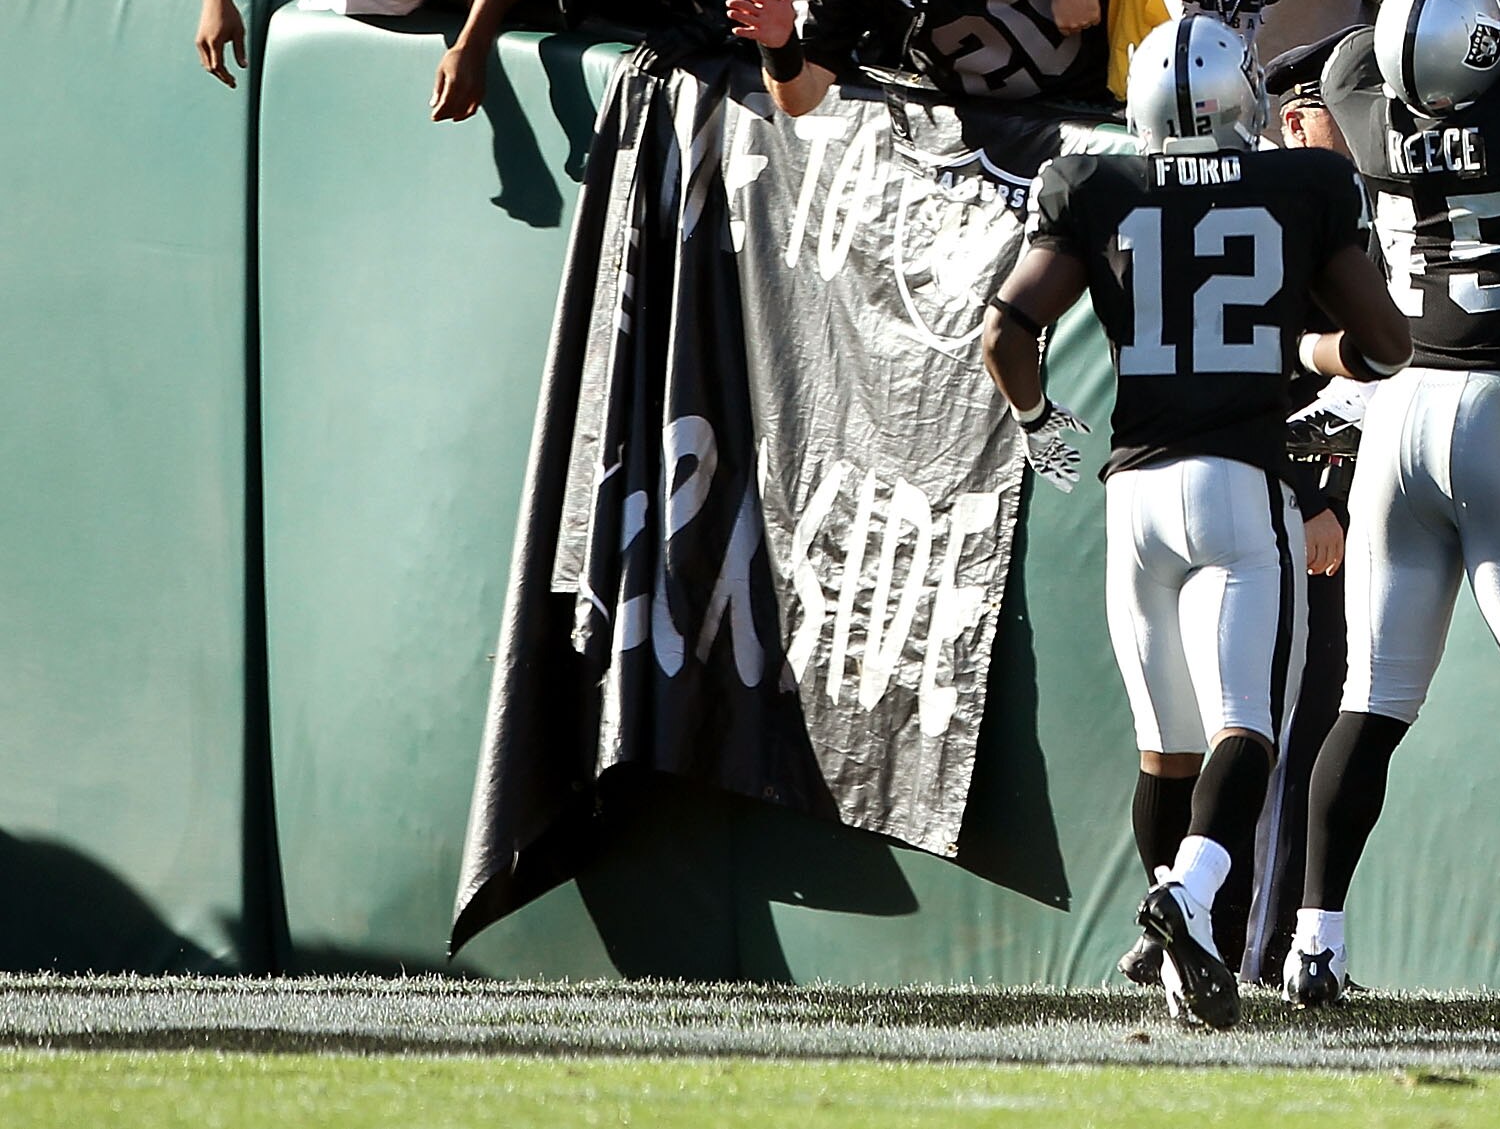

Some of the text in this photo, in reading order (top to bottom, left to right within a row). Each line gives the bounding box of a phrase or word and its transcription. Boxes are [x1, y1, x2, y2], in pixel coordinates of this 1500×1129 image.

[1468, 24, 1483, 61] RAIDER
[1155, 156, 1241, 187] FORD
[1388, 127, 1482, 174] REECE
[1116, 206, 1284, 375] 12
